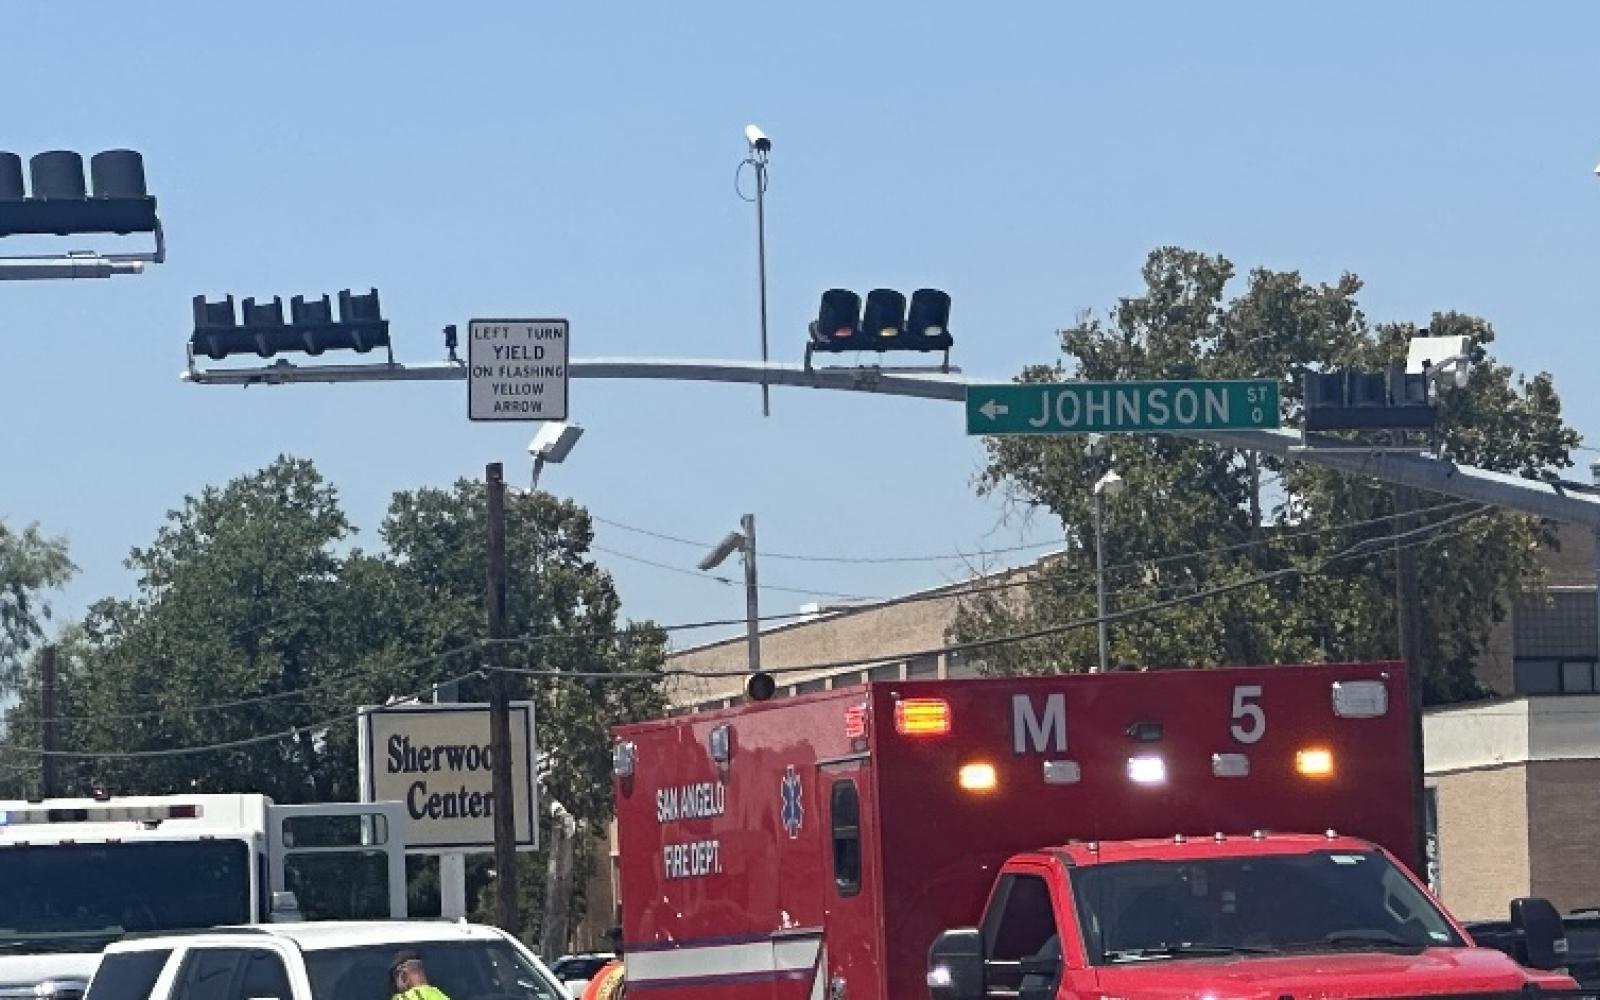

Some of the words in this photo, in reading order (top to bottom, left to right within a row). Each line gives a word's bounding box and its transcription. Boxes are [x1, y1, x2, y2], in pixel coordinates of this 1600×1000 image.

[474, 326, 510, 340] LEFT
[527, 326, 563, 340] TURN
[493, 345, 544, 360] YIELD
[473, 365, 493, 378] ON
[499, 364, 563, 378] FLASHING
[492, 383, 544, 396] YELLOW
[1247, 386, 1268, 402] ST
[494, 400, 541, 413] ARROW
[1028, 387, 1231, 428] JOHNSON
[1012, 693, 1068, 753] M
[1230, 685, 1266, 744] 5
[387, 734, 492, 774] Sherwoo
[406, 780, 495, 820] Center
[656, 786, 679, 823] SAN
[680, 780, 725, 819] ANGELO
[663, 844, 690, 879] FIRE
[691, 840, 722, 876] DEPT.
